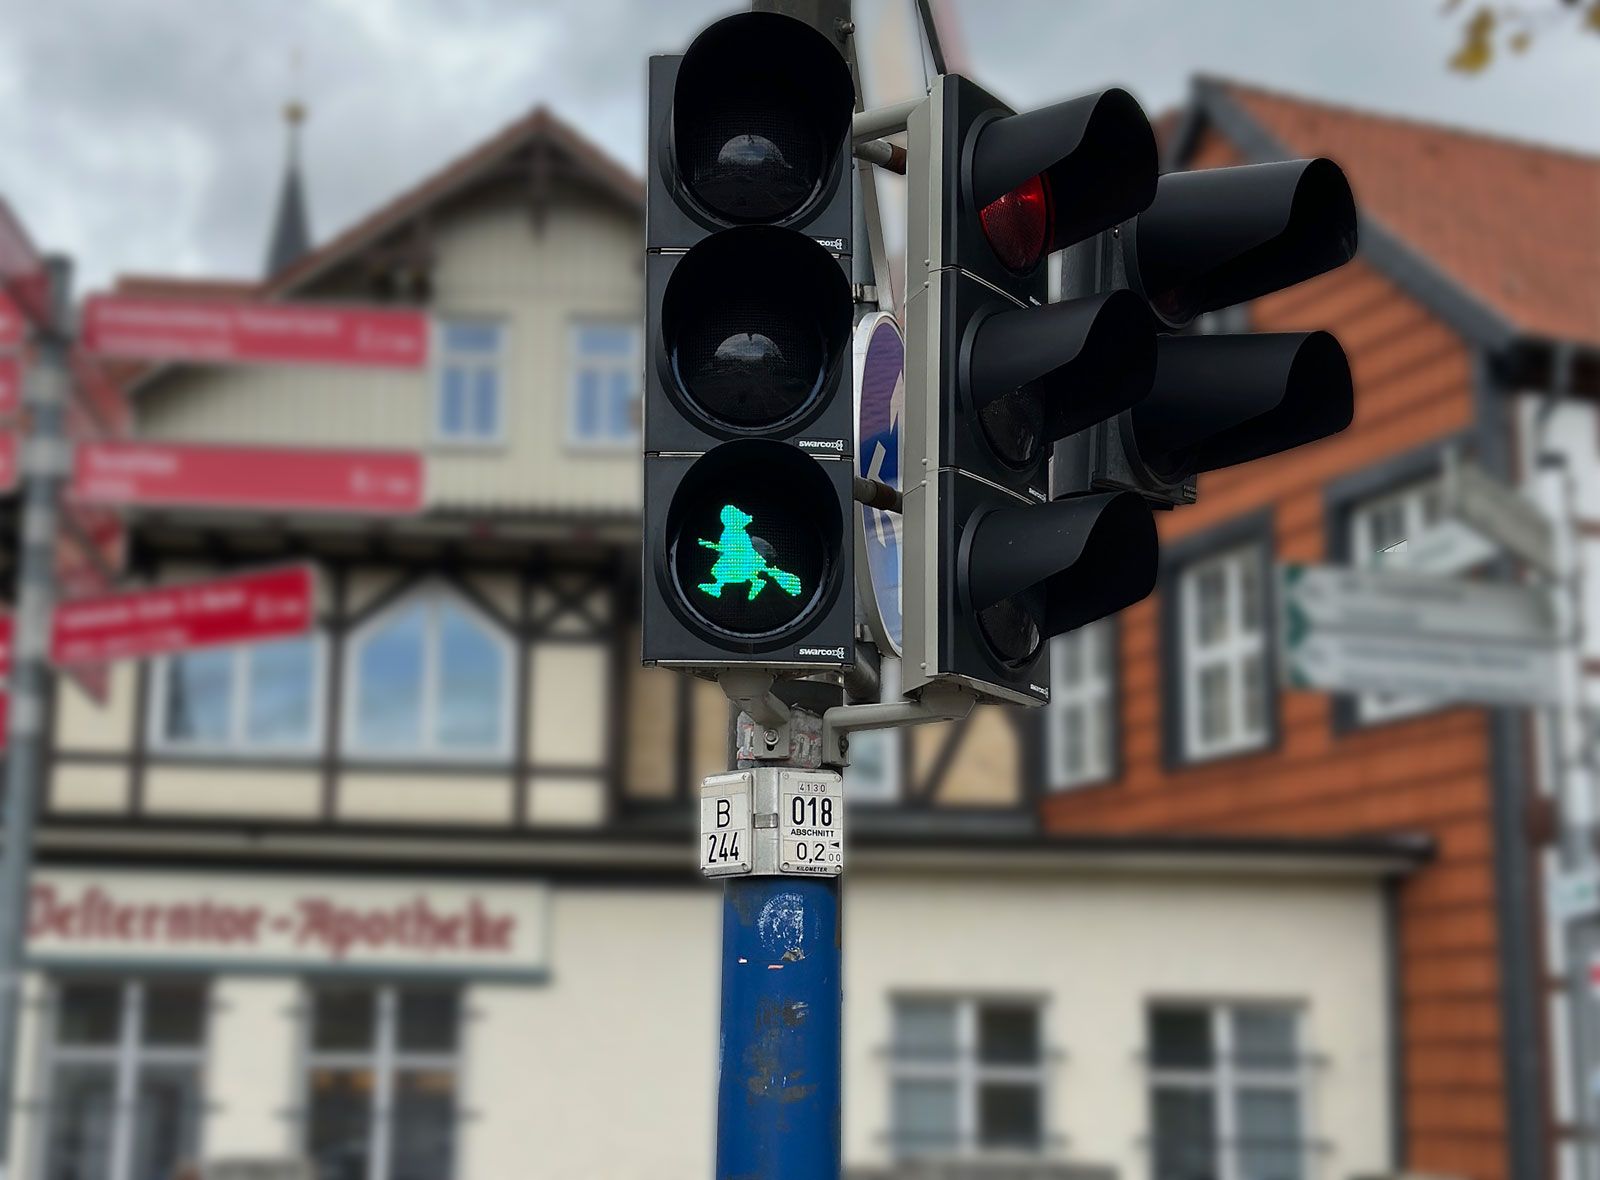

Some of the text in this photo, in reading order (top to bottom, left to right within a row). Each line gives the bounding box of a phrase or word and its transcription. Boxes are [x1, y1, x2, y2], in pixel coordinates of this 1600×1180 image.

[799, 783, 826, 793] 4130
[717, 799, 731, 828] B
[792, 796, 832, 827] 018
[790, 828, 835, 838] ABSCHNITT
[708, 831, 740, 864] 244
[796, 842, 826, 864] 0,2
